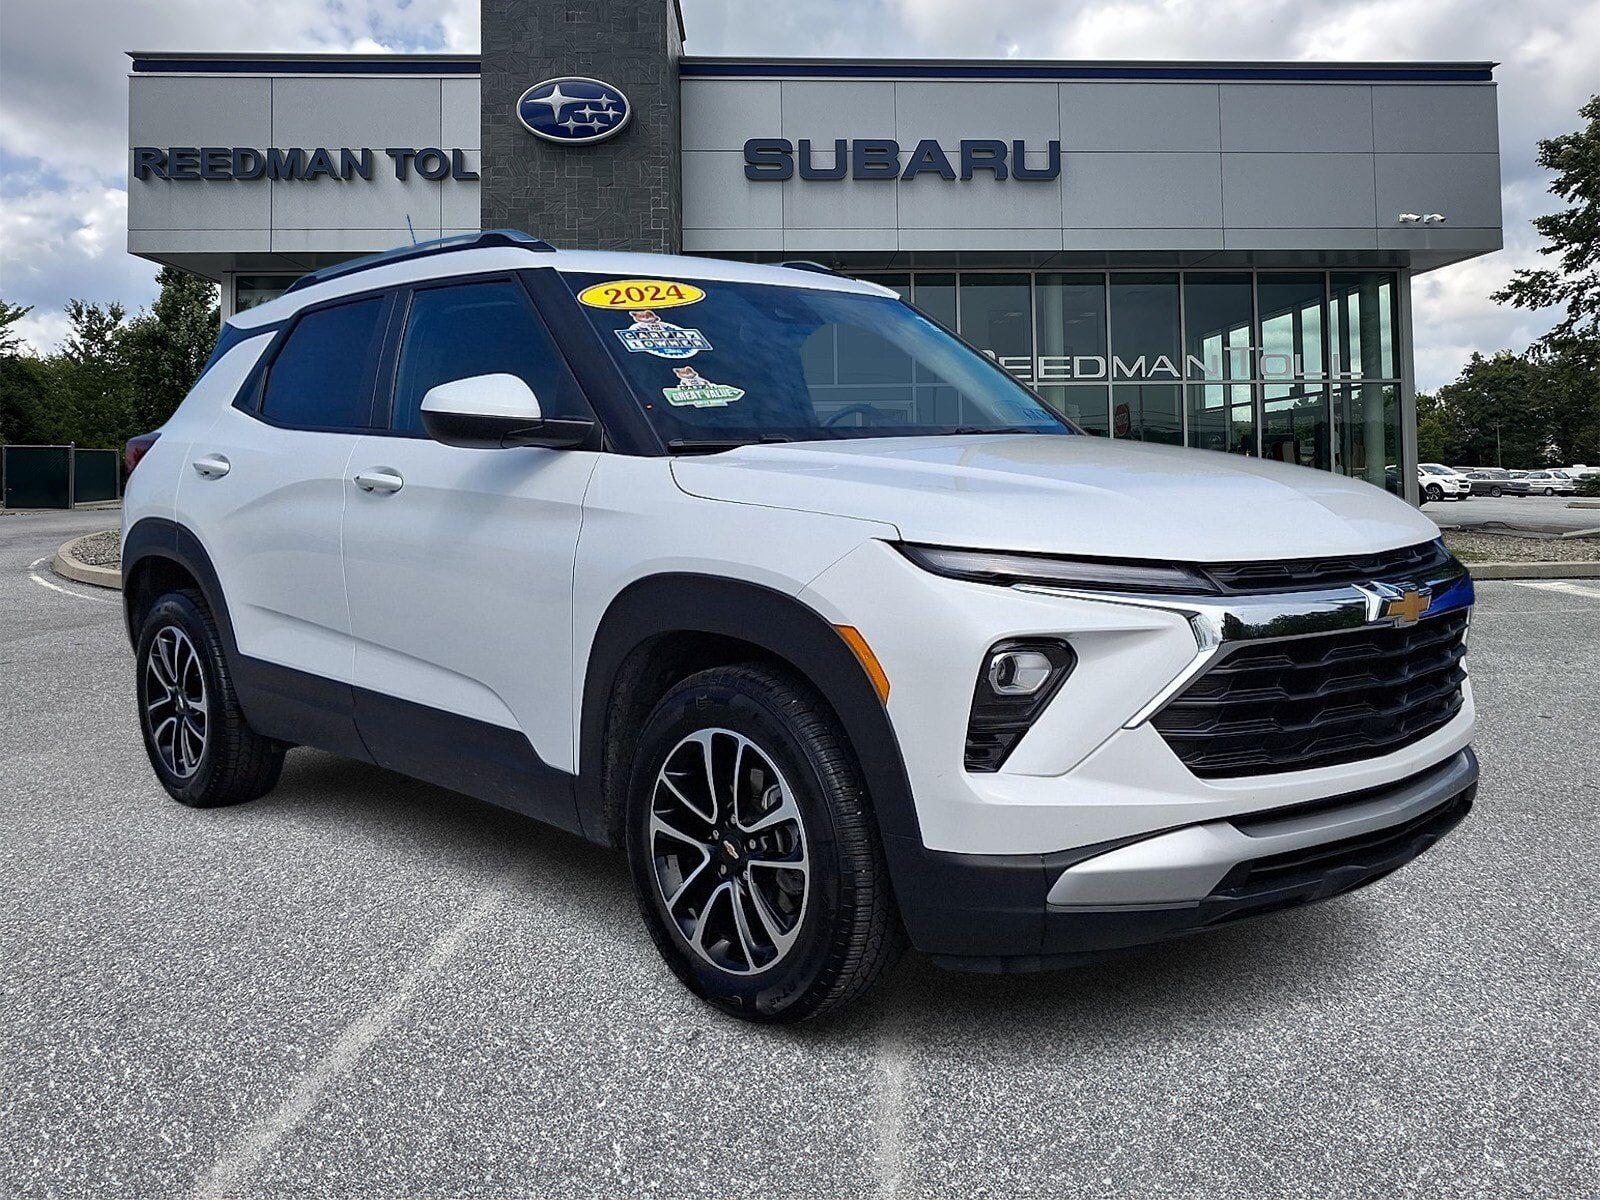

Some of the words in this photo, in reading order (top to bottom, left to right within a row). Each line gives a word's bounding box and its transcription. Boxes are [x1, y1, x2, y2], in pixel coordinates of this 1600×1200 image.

[133, 147, 372, 181] REEDMAN
[385, 147, 480, 181] TOL
[743, 138, 1061, 180] SUBARU
[604, 285, 685, 305] 2024
[980, 349, 1218, 378] EEDMAN
[672, 390, 702, 401] GREAT
